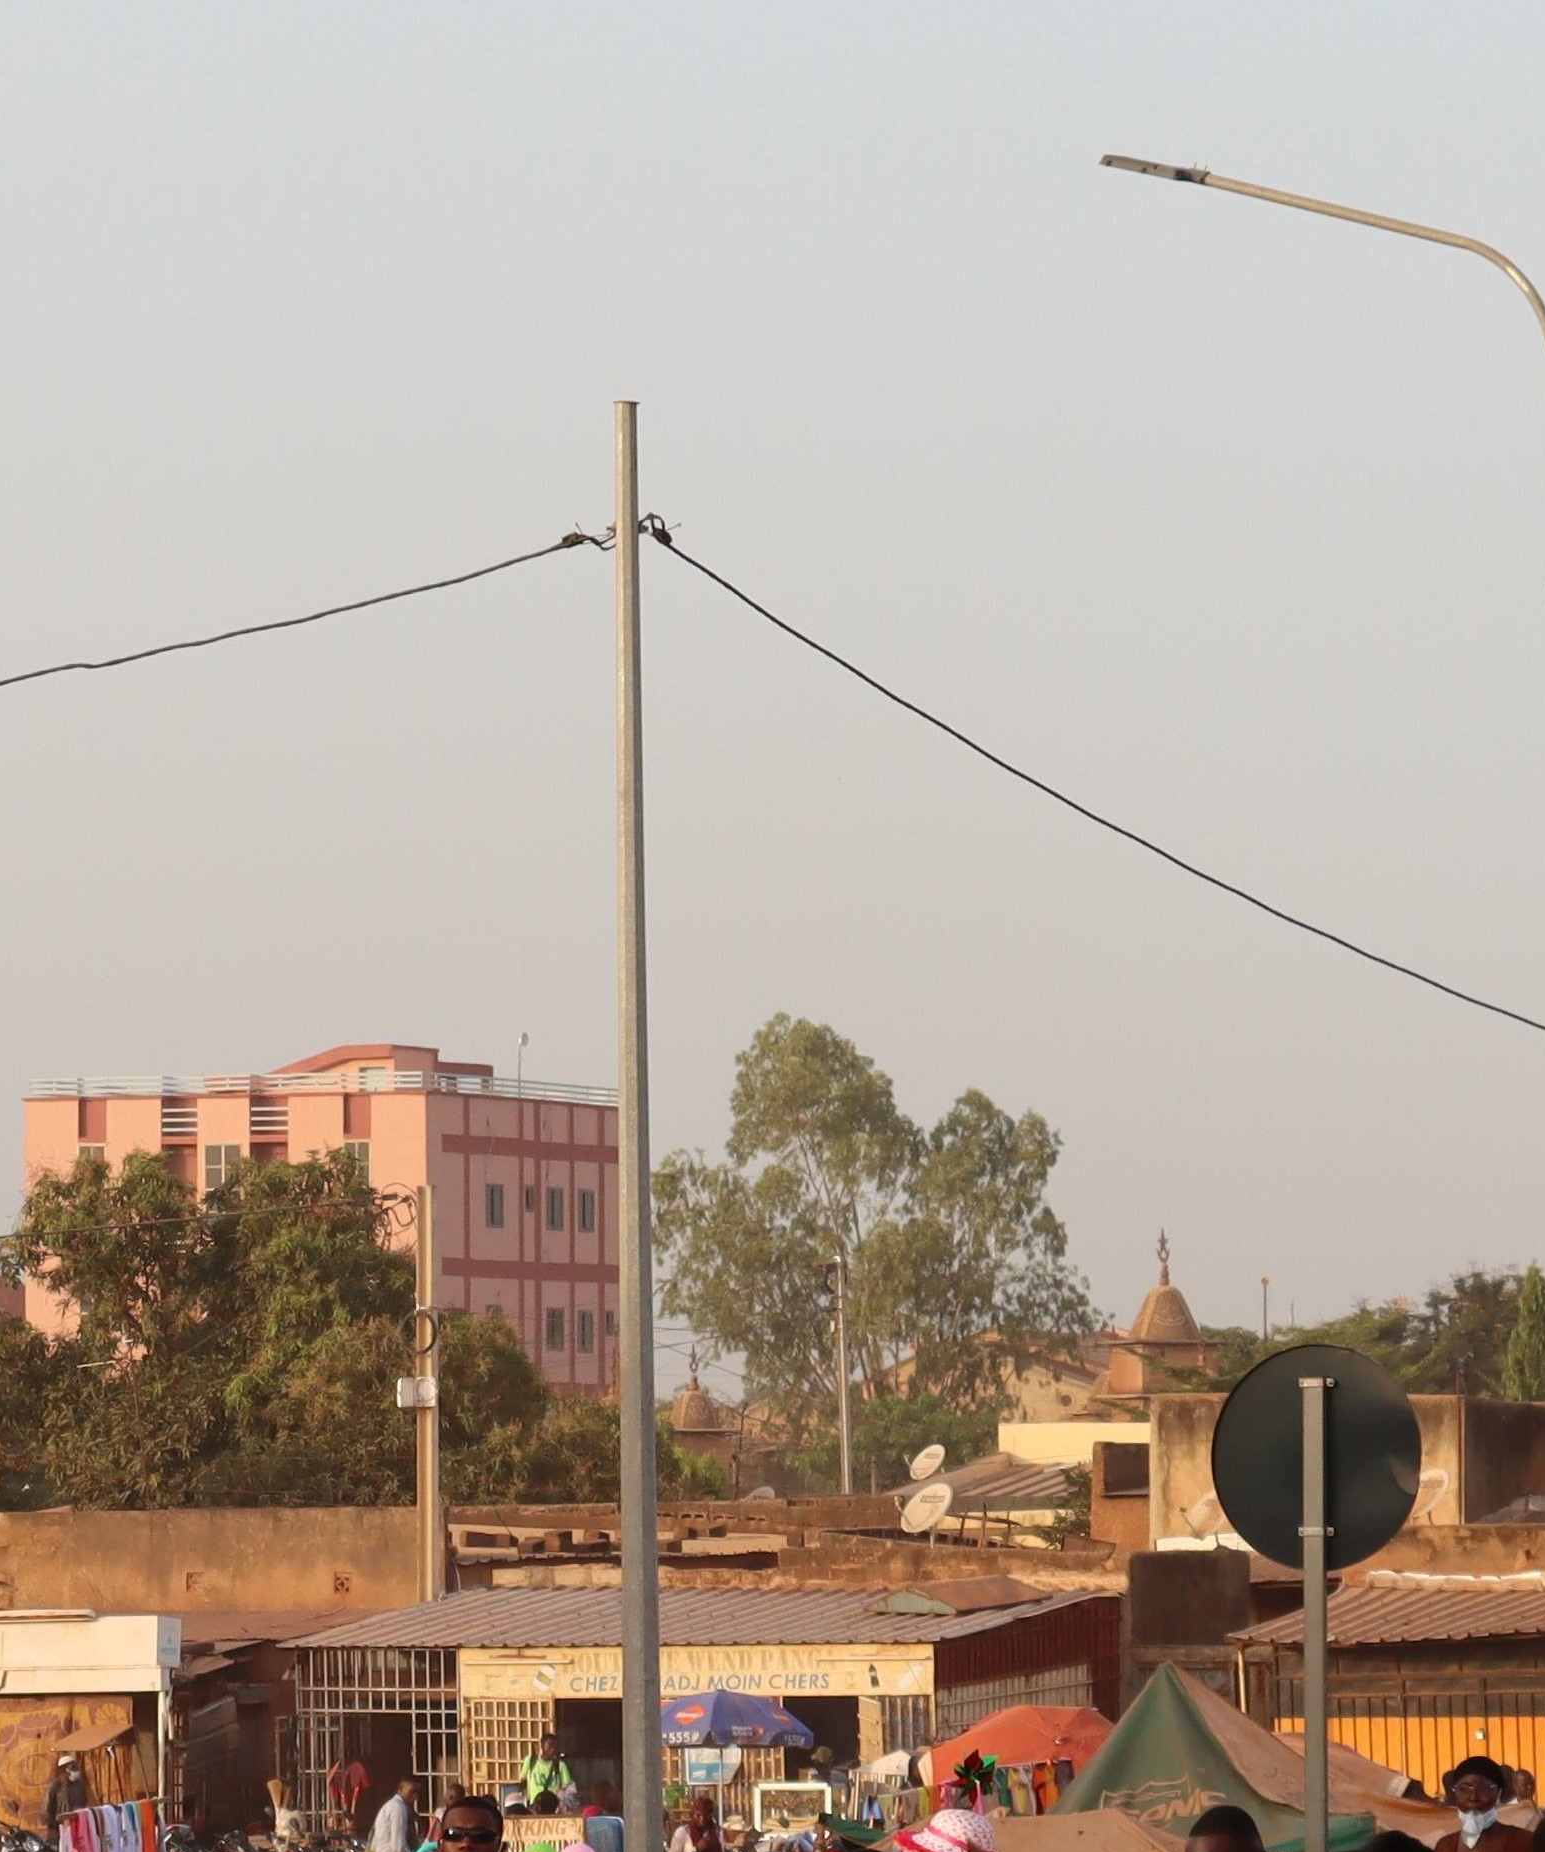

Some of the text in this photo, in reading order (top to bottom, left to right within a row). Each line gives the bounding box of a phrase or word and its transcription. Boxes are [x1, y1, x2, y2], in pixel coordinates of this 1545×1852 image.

[569, 1677, 619, 1693] CHEZ
[708, 1674, 763, 1690] MOIN
[768, 1673, 830, 1690] CHERS
